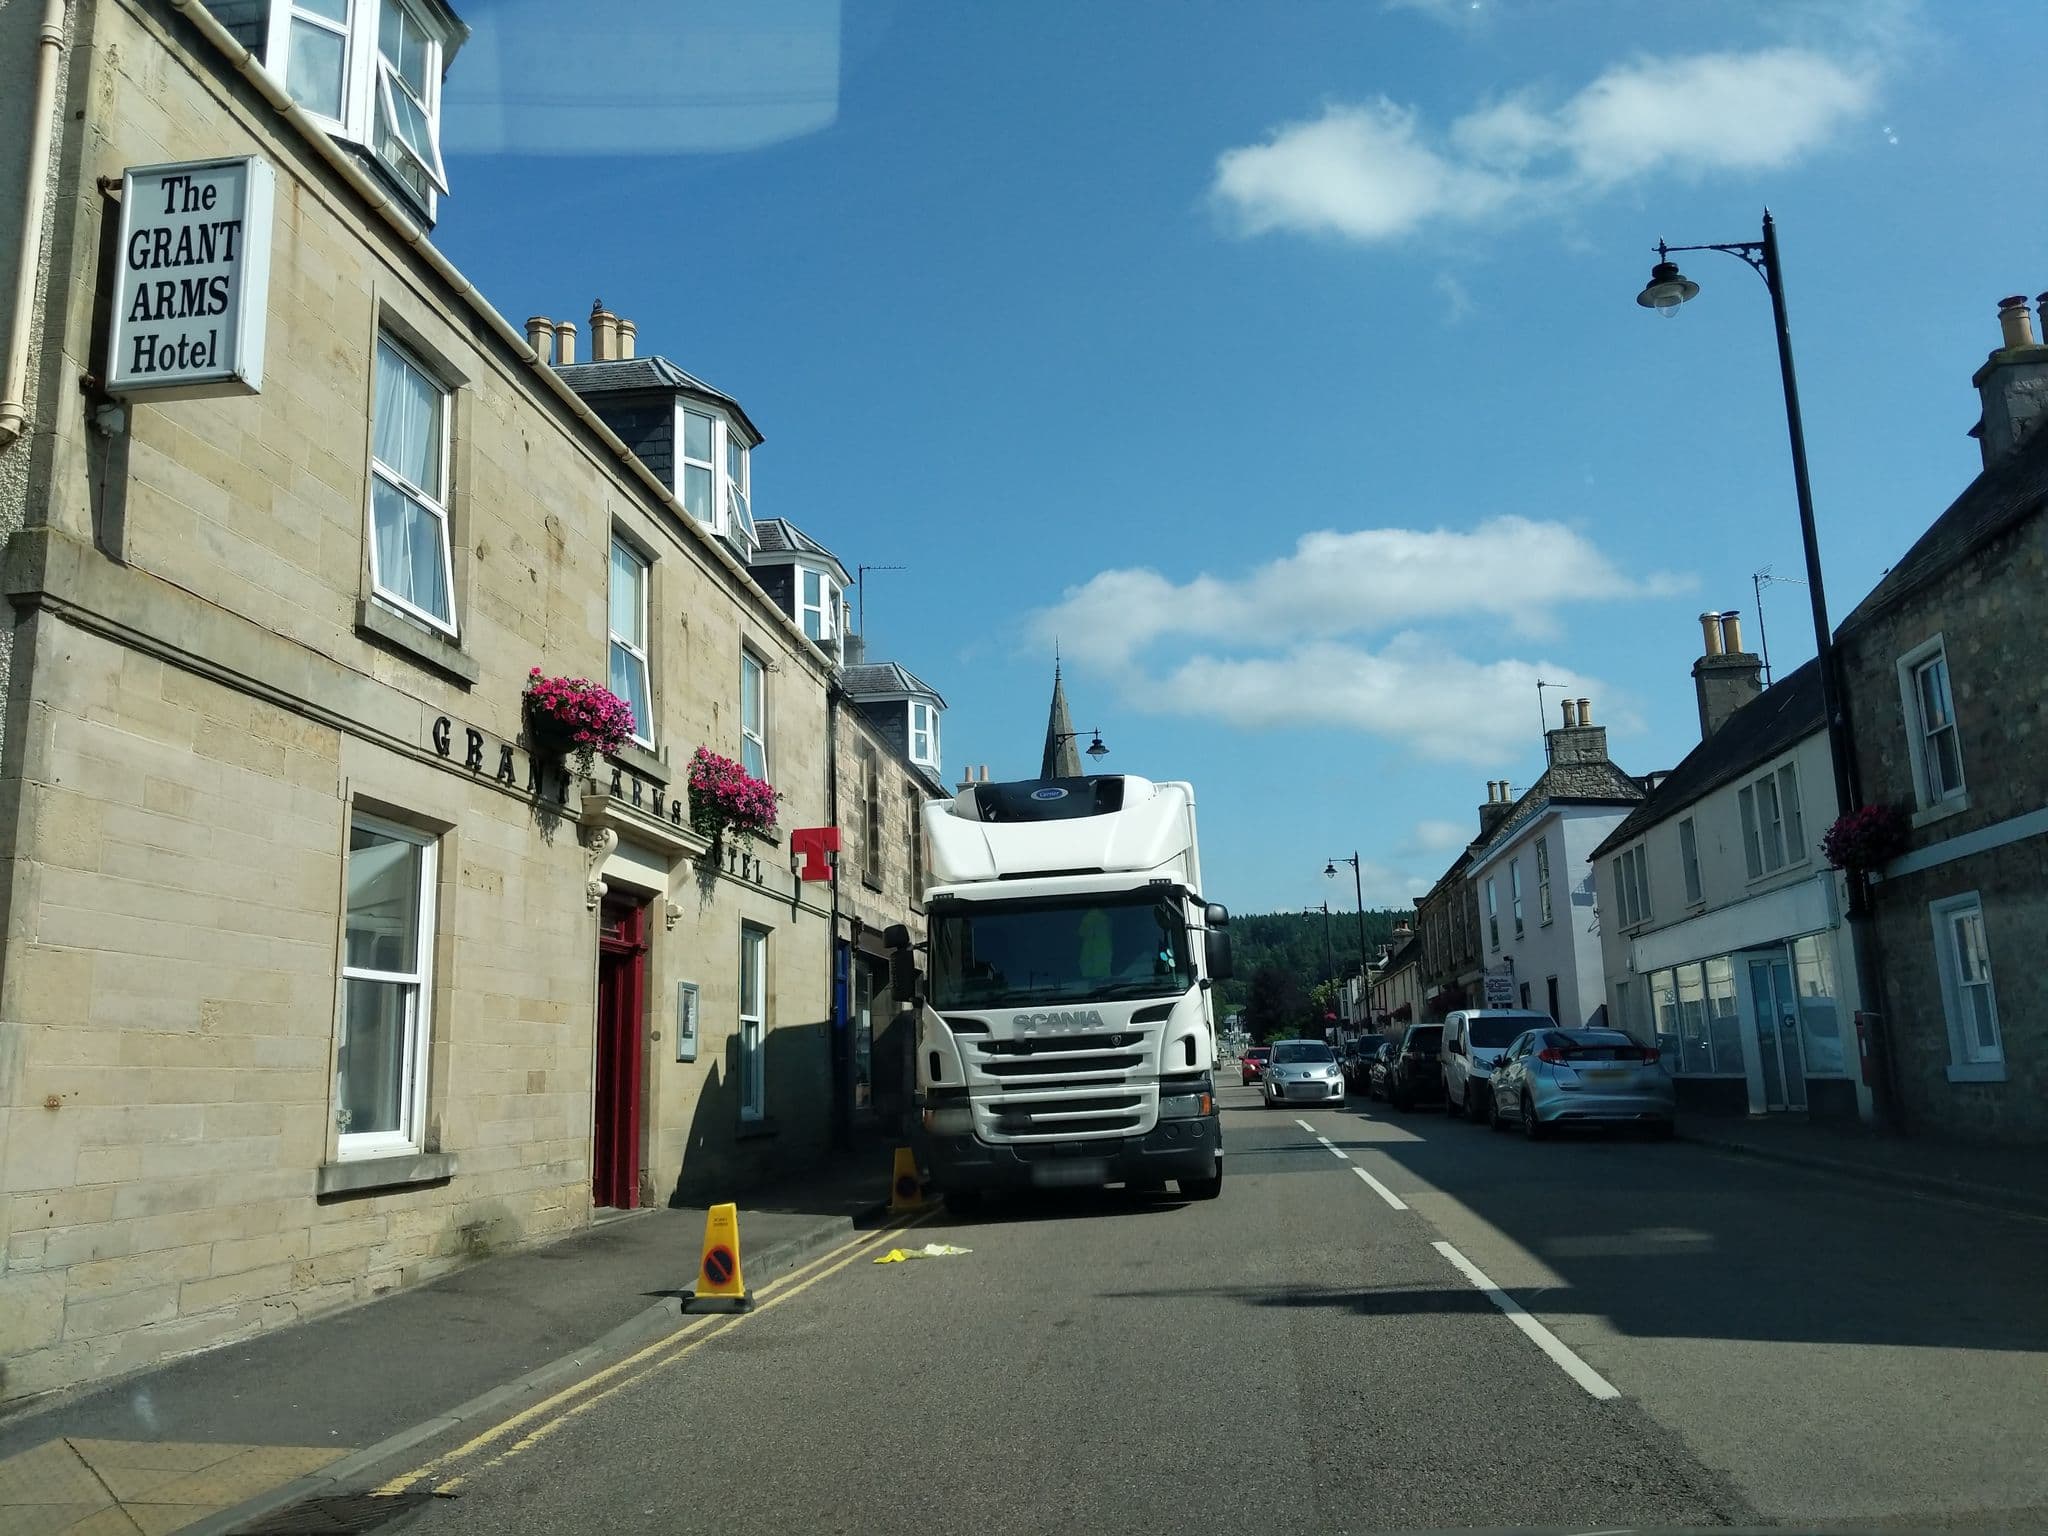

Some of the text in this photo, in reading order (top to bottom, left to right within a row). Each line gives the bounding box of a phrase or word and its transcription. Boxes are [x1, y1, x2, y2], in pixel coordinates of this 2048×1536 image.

[161, 175, 217, 214] The
[128, 220, 241, 270] GRANT
[128, 275, 229, 322] ARMS
[131, 330, 217, 373] Hotel
[610, 768, 682, 826] ARMS
[1013, 1009, 1104, 1031] SCANIA
